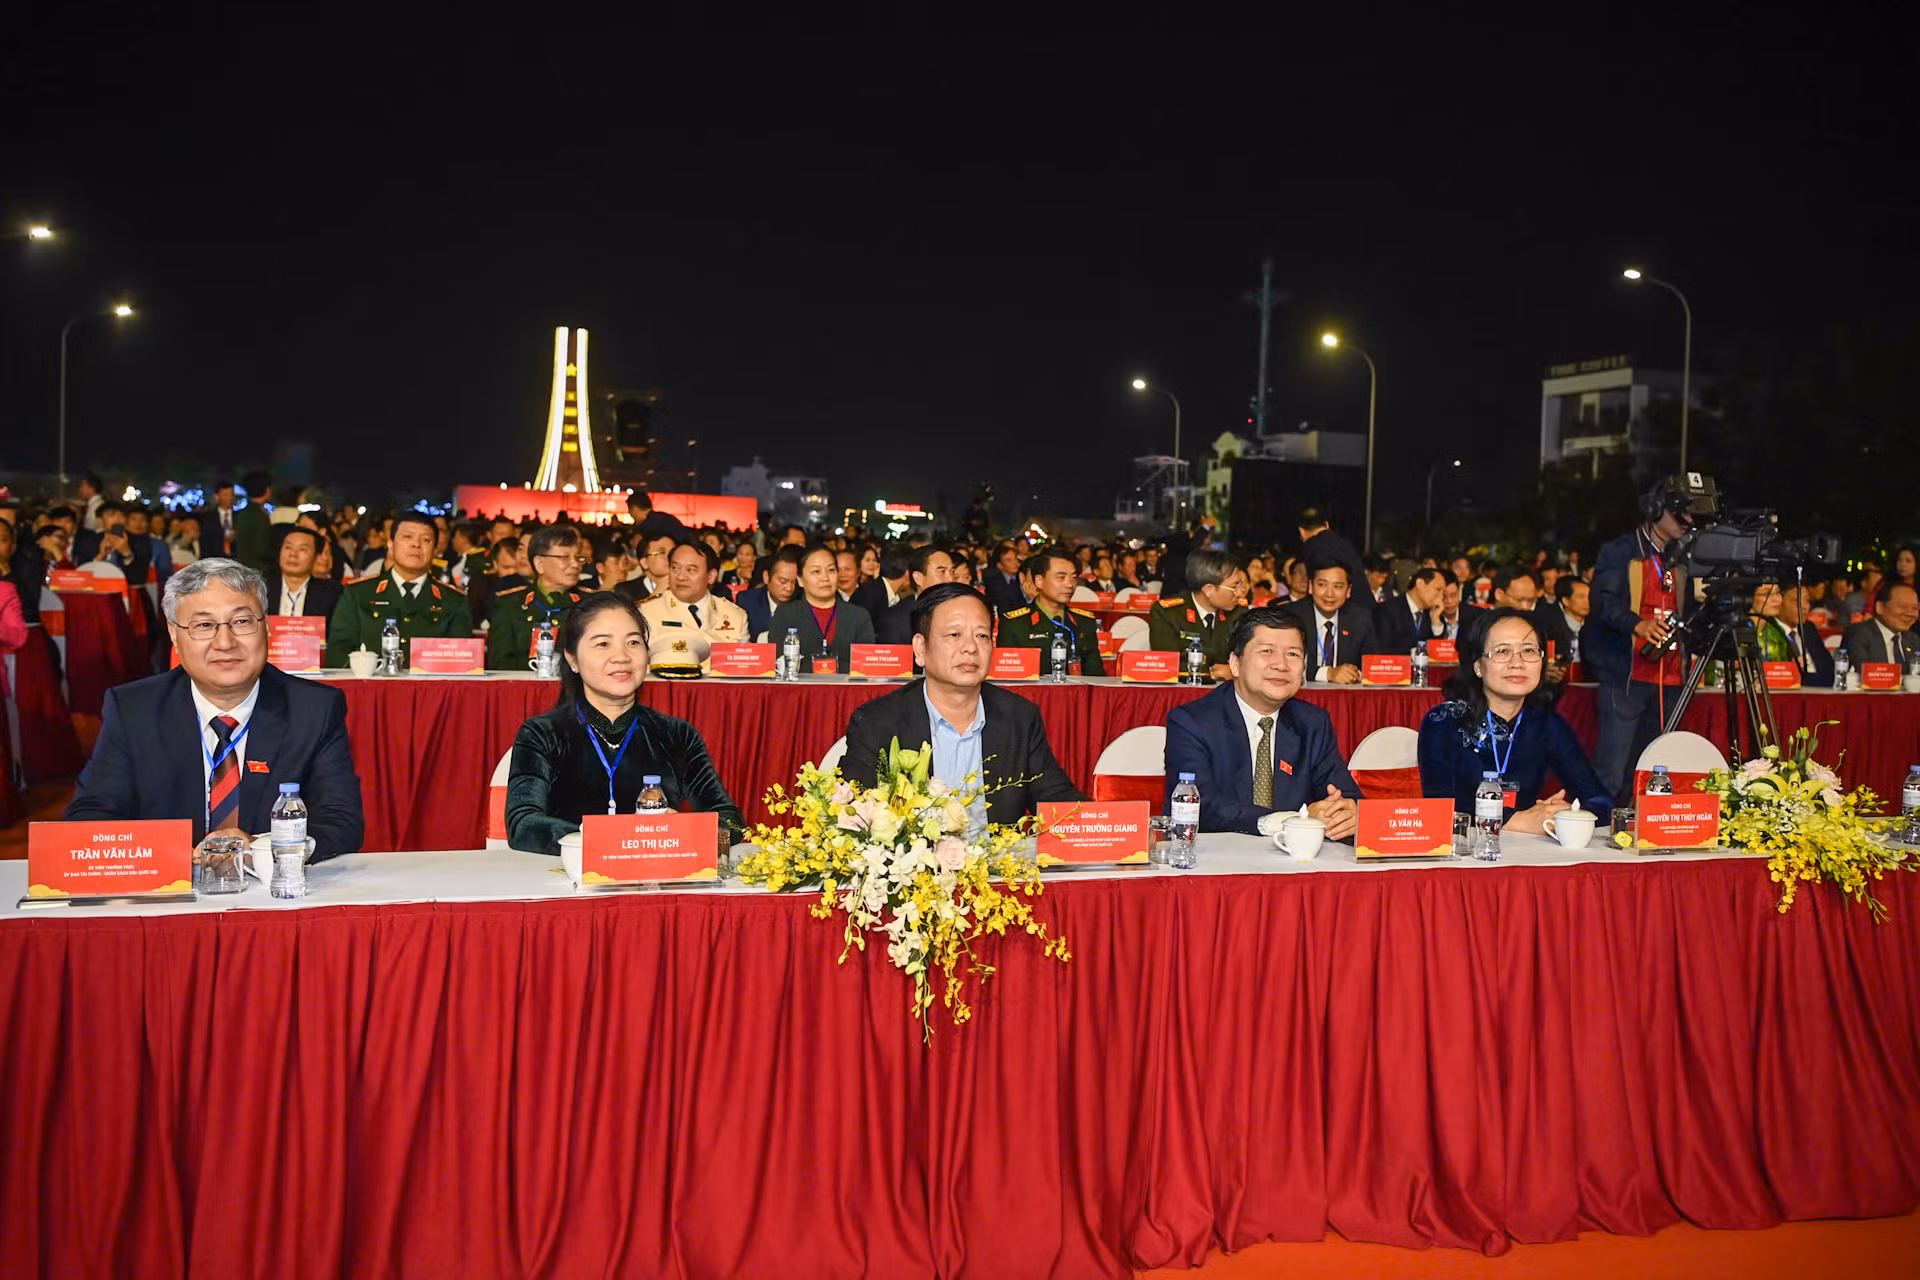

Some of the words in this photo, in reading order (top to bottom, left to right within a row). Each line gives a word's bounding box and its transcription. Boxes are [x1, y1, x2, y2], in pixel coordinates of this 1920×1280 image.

[635, 824, 654, 833] ĐỒNG
[656, 824, 668, 832] CHÍ
[1082, 822, 1112, 832] TRƯỜNG
[1114, 824, 1138, 832] GIANG
[1389, 819, 1397, 829] TẠ
[1398, 818, 1412, 827] VĂN
[1413, 819, 1422, 828] HẠ
[93, 833, 116, 842] ĐỒNG
[118, 833, 132, 841] CHÍ
[622, 840, 639, 849] LEO
[641, 839, 656, 849] THỊ
[658, 838, 679, 849] LỊCH
[70, 847, 100, 860] TRẦN
[103, 847, 126, 859] VĂN
[128, 846, 152, 858] LÂM
